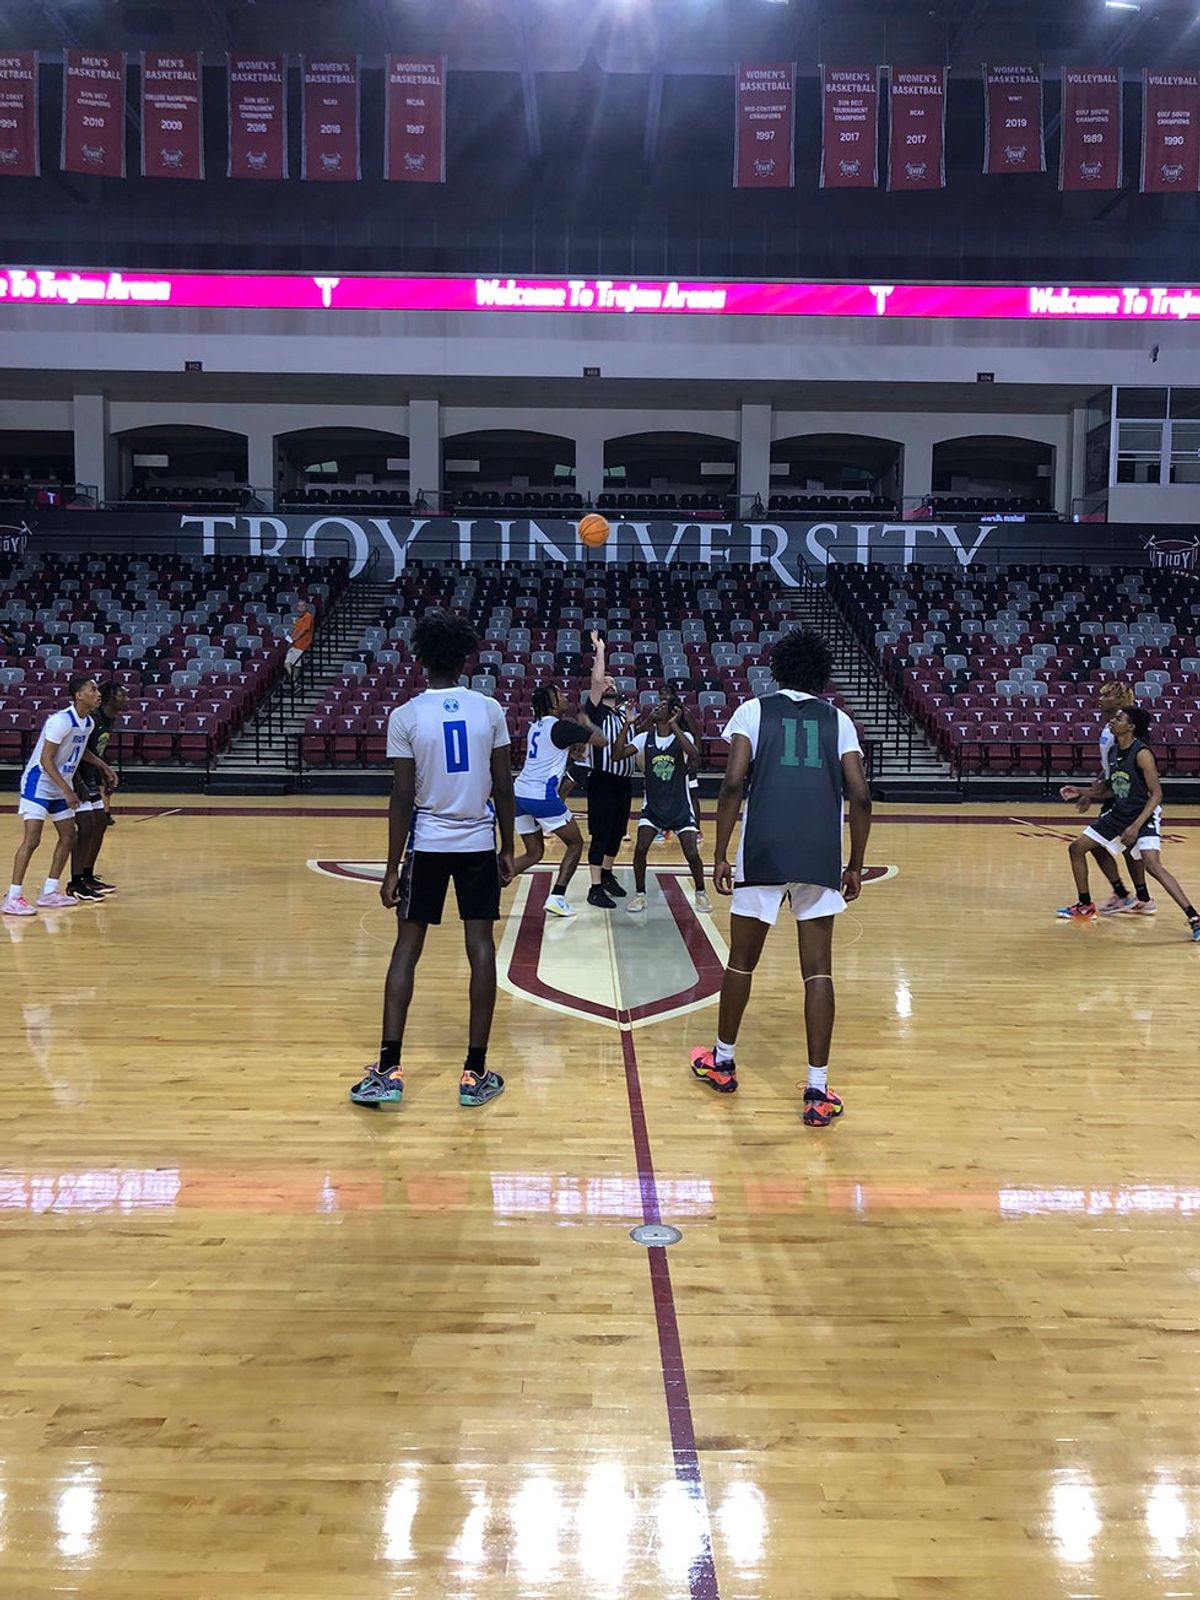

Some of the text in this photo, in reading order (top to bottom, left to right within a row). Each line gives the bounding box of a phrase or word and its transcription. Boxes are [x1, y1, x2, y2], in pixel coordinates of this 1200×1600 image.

[82, 58, 108, 67] MEN'S
[158, 59, 184, 68] MEN'S
[237, 61, 276, 70] WOMEN'S
[311, 63, 350, 72] WOMEN'S
[396, 63, 436, 73] WOMEN'S
[68, 68, 121, 80] BASKETBALL
[145, 70, 197, 81] BASKETBALL
[232, 73, 282, 82] BASKETBALL
[305, 74, 356, 84] BASKETBALL
[746, 70, 786, 79] WOMEN'S
[831, 72, 870, 81] WOMEN'S
[898, 74, 937, 83] WOMEN'S
[988, 75, 1040, 83] BASKETBALL
[390, 74, 441, 85] BASKETBALL
[1067, 75, 1118, 84] VOLLEYBALL
[1149, 77, 1198, 85] VOLLEYBALL
[740, 82, 791, 91] BASKETBALL
[825, 83, 876, 93] BASKETBALL
[892, 85, 942, 95] BASKETBALL
[83, 116, 104, 128] 2010
[1006, 118, 1027, 128] 2019
[406, 124, 424, 134] 1997
[756, 131, 775, 140] 1997
[840, 132, 860, 142] 2017
[906, 134, 927, 144] 2017
[1164, 136, 1184, 145] 1990
[8, 271, 35, 298] To
[36, 272, 106, 304] Trojan
[106, 273, 171, 300] Arena
[475, 279, 727, 312] Welcome To Trojan Arena
[1028, 288, 1120, 314] Welcome
[1122, 288, 1148, 314] To
[180, 514, 999, 588] TROY UNIVERSITY
[443, 720, 470, 773] 0
[529, 732, 541, 759] 5
[780, 718, 822, 768] 11
